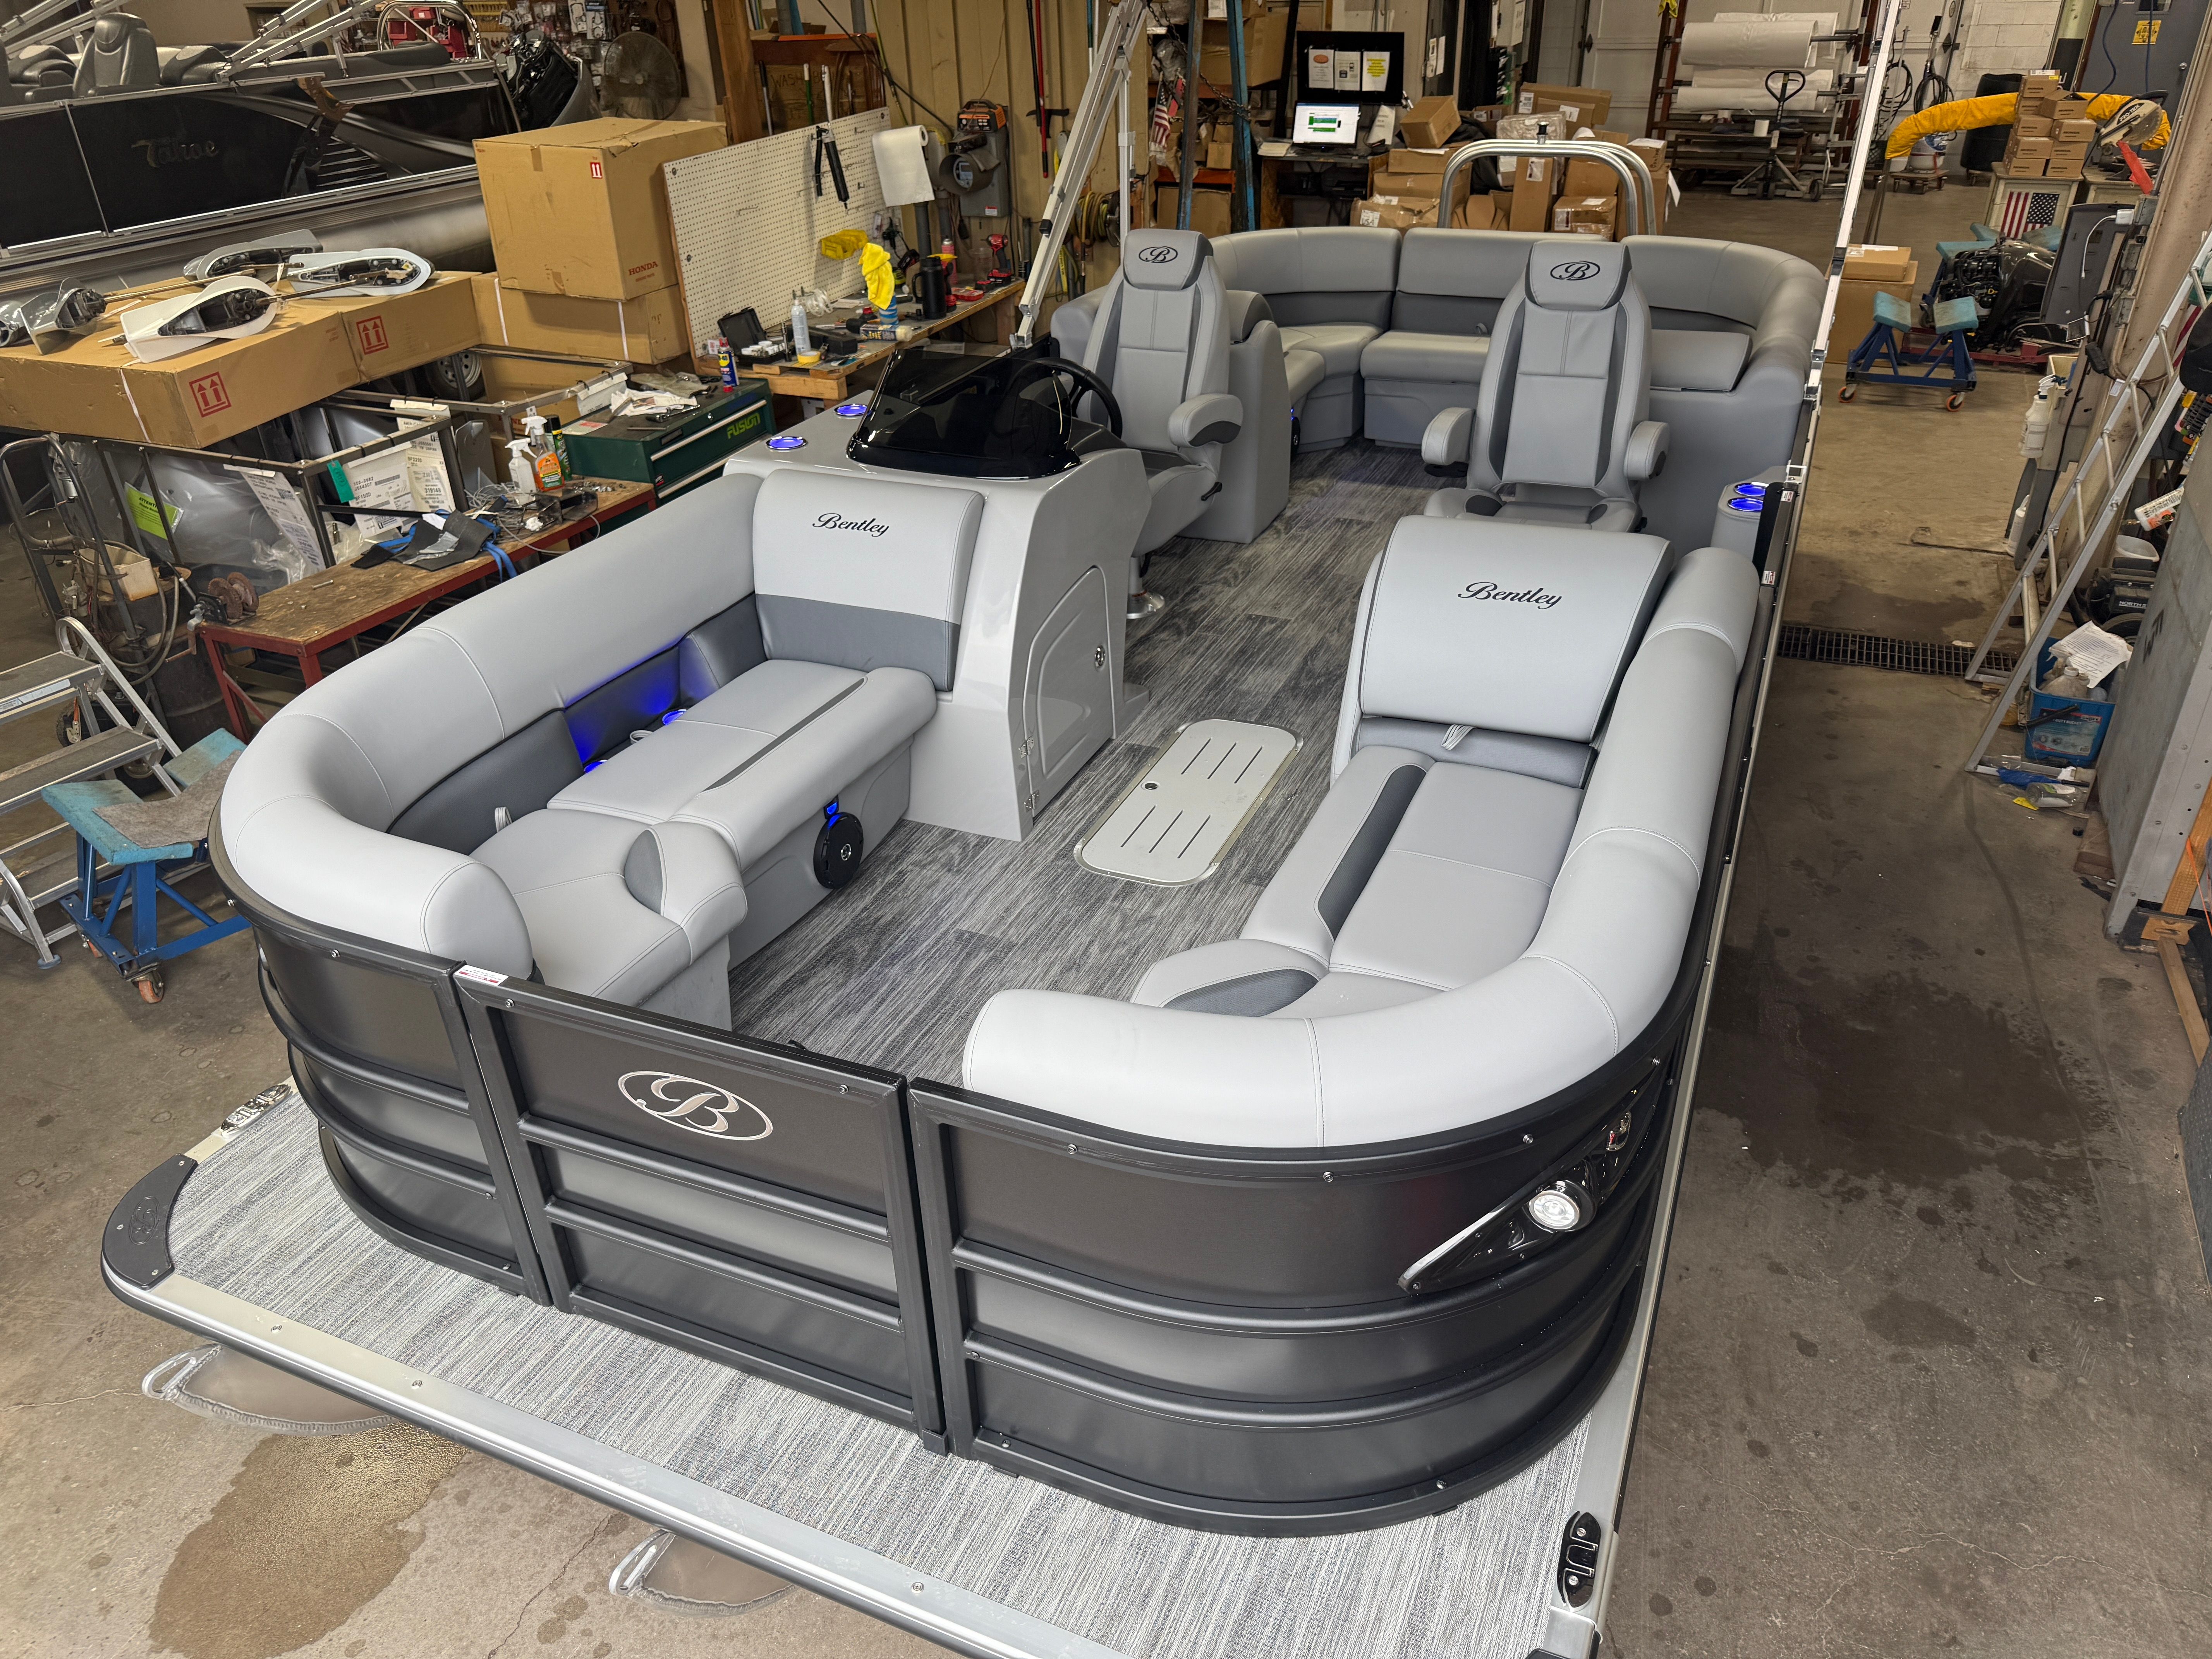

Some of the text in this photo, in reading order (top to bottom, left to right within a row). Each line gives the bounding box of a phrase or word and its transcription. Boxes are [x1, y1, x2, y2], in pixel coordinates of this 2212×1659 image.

[628, 261, 658, 276] HONDA
[727, 412, 761, 439] FUSION
[812, 513, 889, 537] Bentley
[1458, 582, 1562, 610] Bentley
